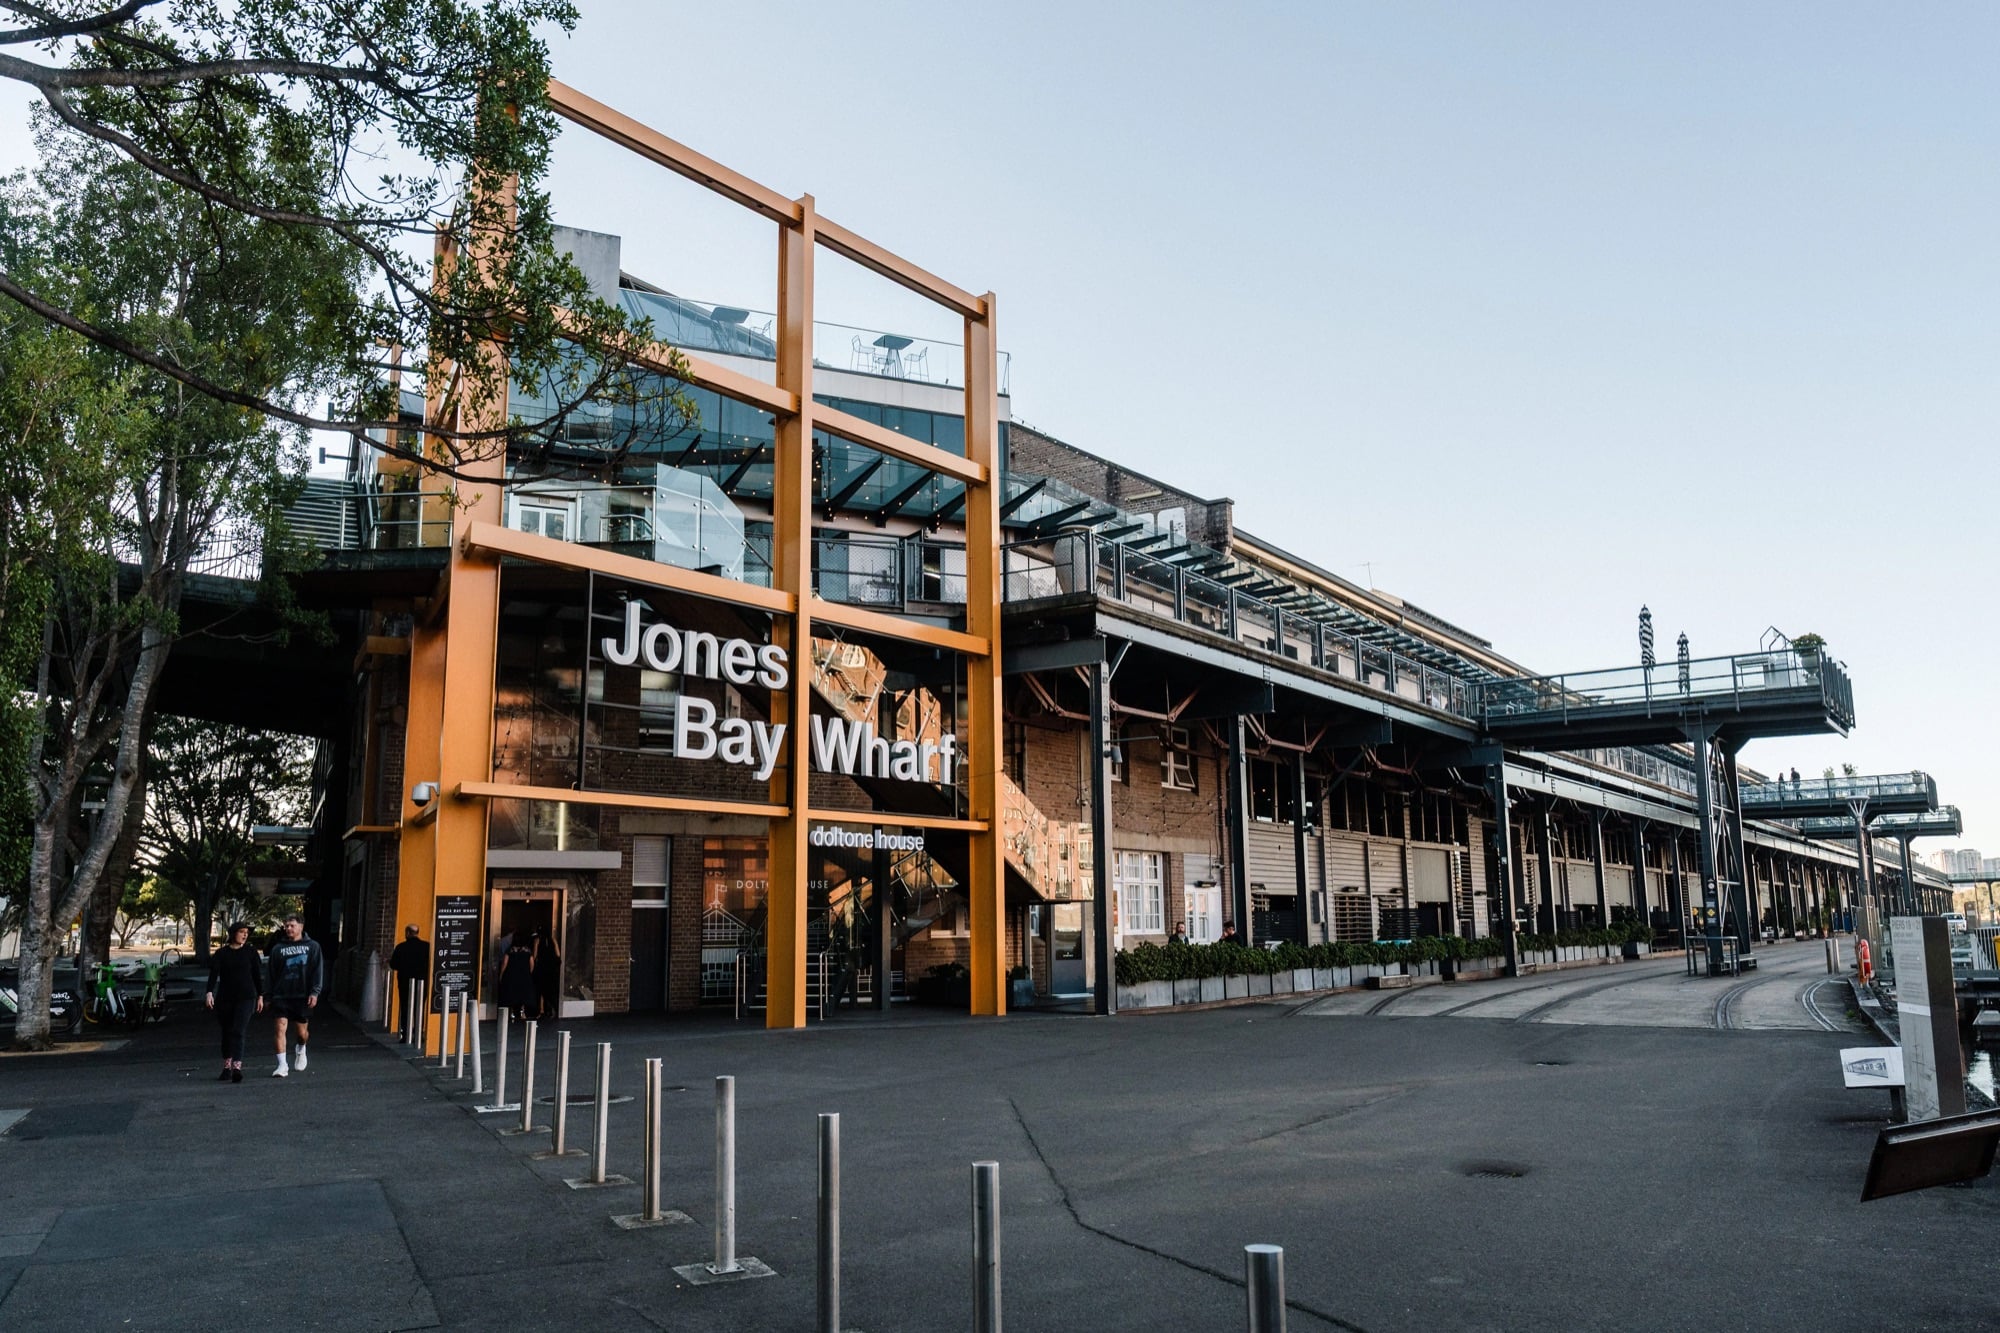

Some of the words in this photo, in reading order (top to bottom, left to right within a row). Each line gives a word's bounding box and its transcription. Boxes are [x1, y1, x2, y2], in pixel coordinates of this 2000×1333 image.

[602, 601, 789, 690] Jones
[673, 695, 787, 781] Bay
[809, 713, 956, 784] Wharf
[810, 825, 874, 849] doltone
[874, 829, 924, 851] house
